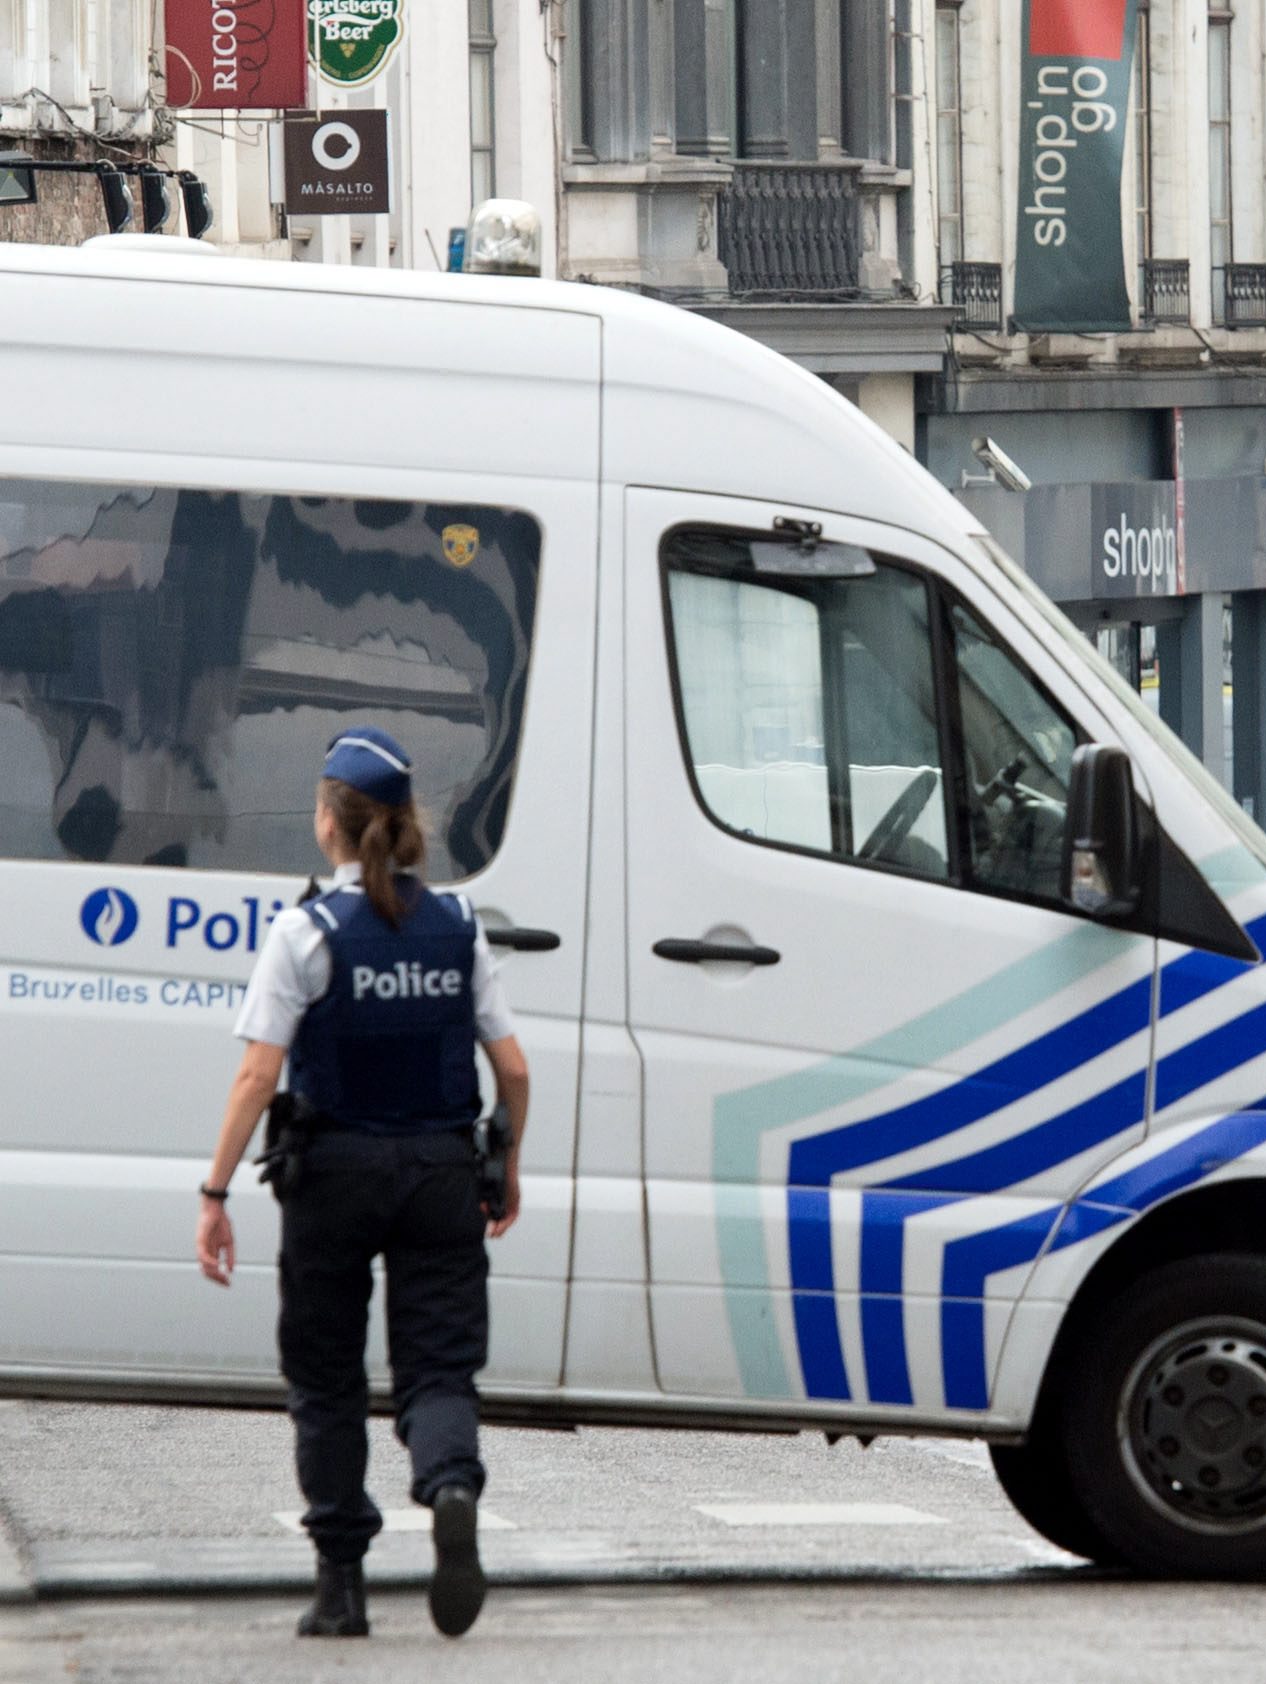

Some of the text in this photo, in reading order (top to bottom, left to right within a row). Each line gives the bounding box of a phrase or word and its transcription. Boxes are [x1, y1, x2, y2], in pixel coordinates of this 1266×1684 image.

[308, 0, 393, 18] arlsberg
[325, 21, 373, 40] Beer
[1073, 66, 1116, 133] go
[1025, 65, 1076, 246] shop'n
[9, 973, 249, 1008] Bruxelles CAPIT
[353, 961, 462, 1000] Police
